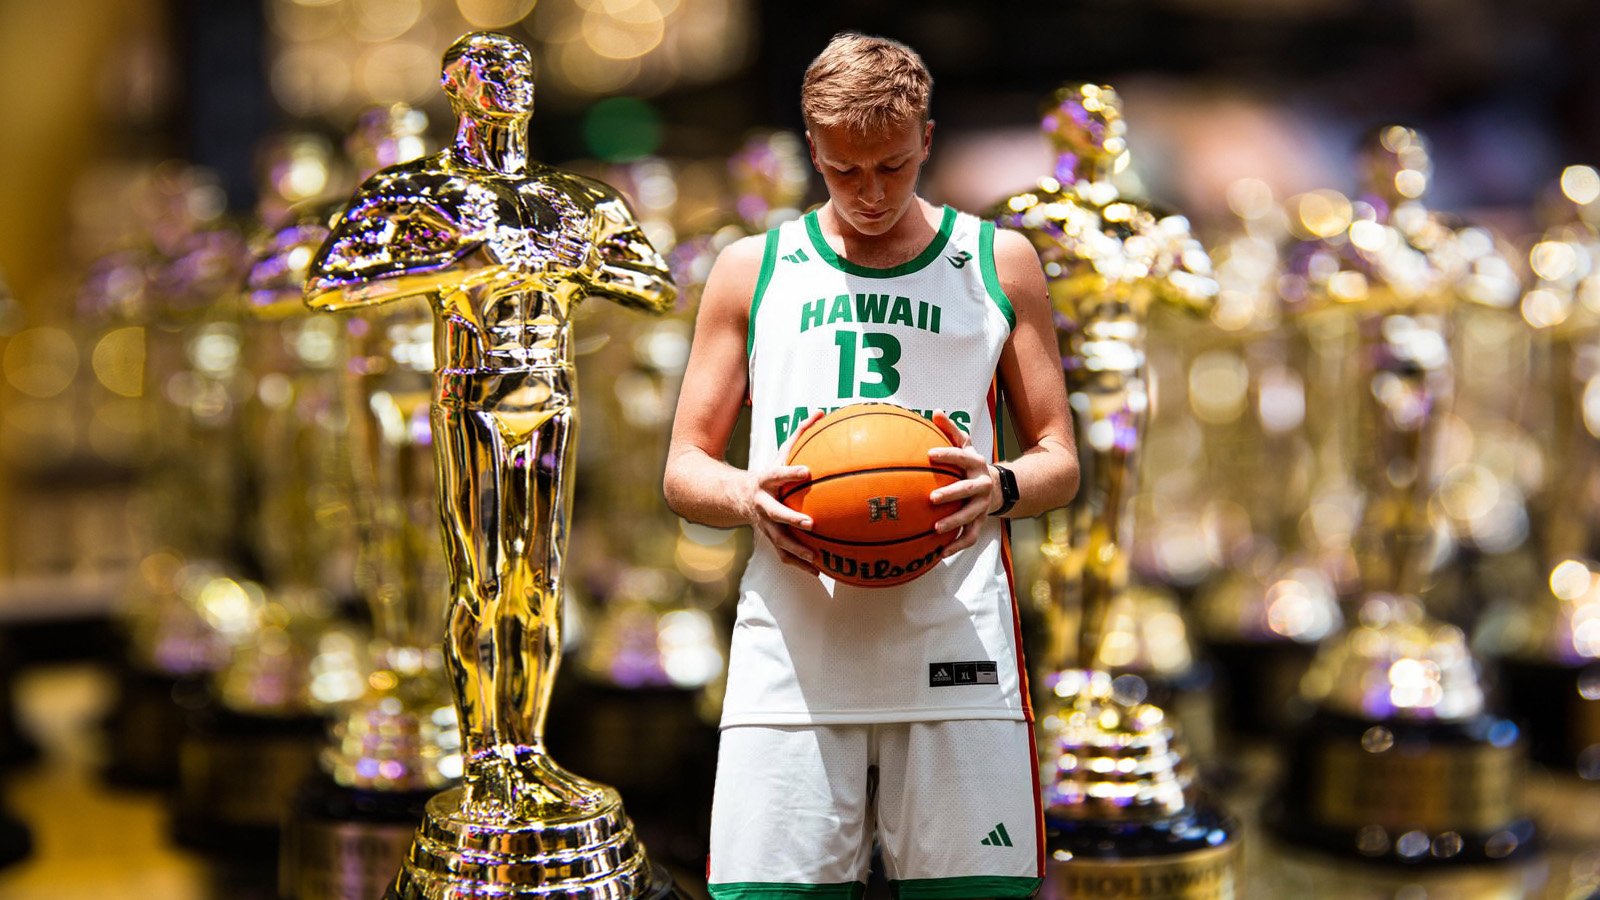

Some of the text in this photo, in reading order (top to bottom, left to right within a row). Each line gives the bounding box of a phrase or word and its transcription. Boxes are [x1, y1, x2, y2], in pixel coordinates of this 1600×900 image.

[800, 293, 941, 334] HAWAII
[834, 329, 902, 399] 13
[961, 671, 971, 680] XL
